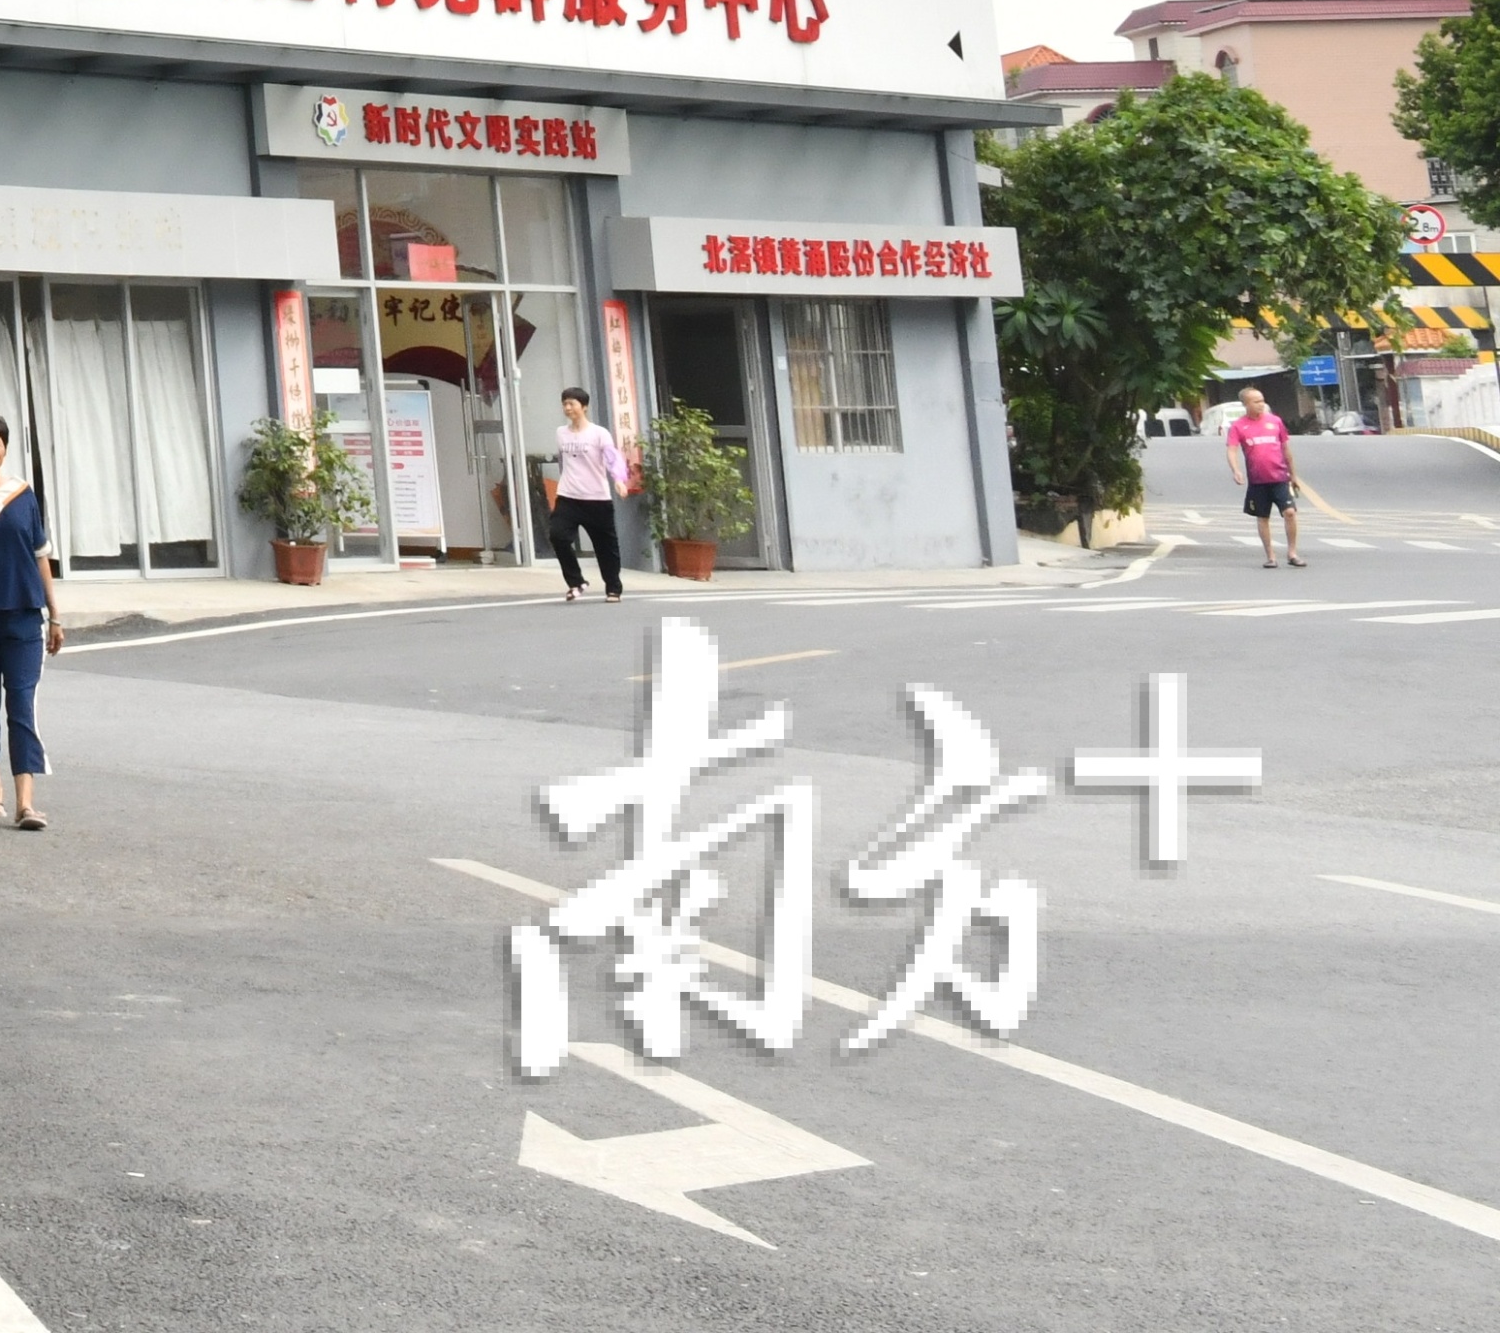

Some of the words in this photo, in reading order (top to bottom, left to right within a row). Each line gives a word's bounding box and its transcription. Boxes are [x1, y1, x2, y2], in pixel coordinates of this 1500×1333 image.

[362, 101, 598, 160] 新时代文明实践站
[701, 234, 992, 279] 北滘镇黄涌股份合作经济社
